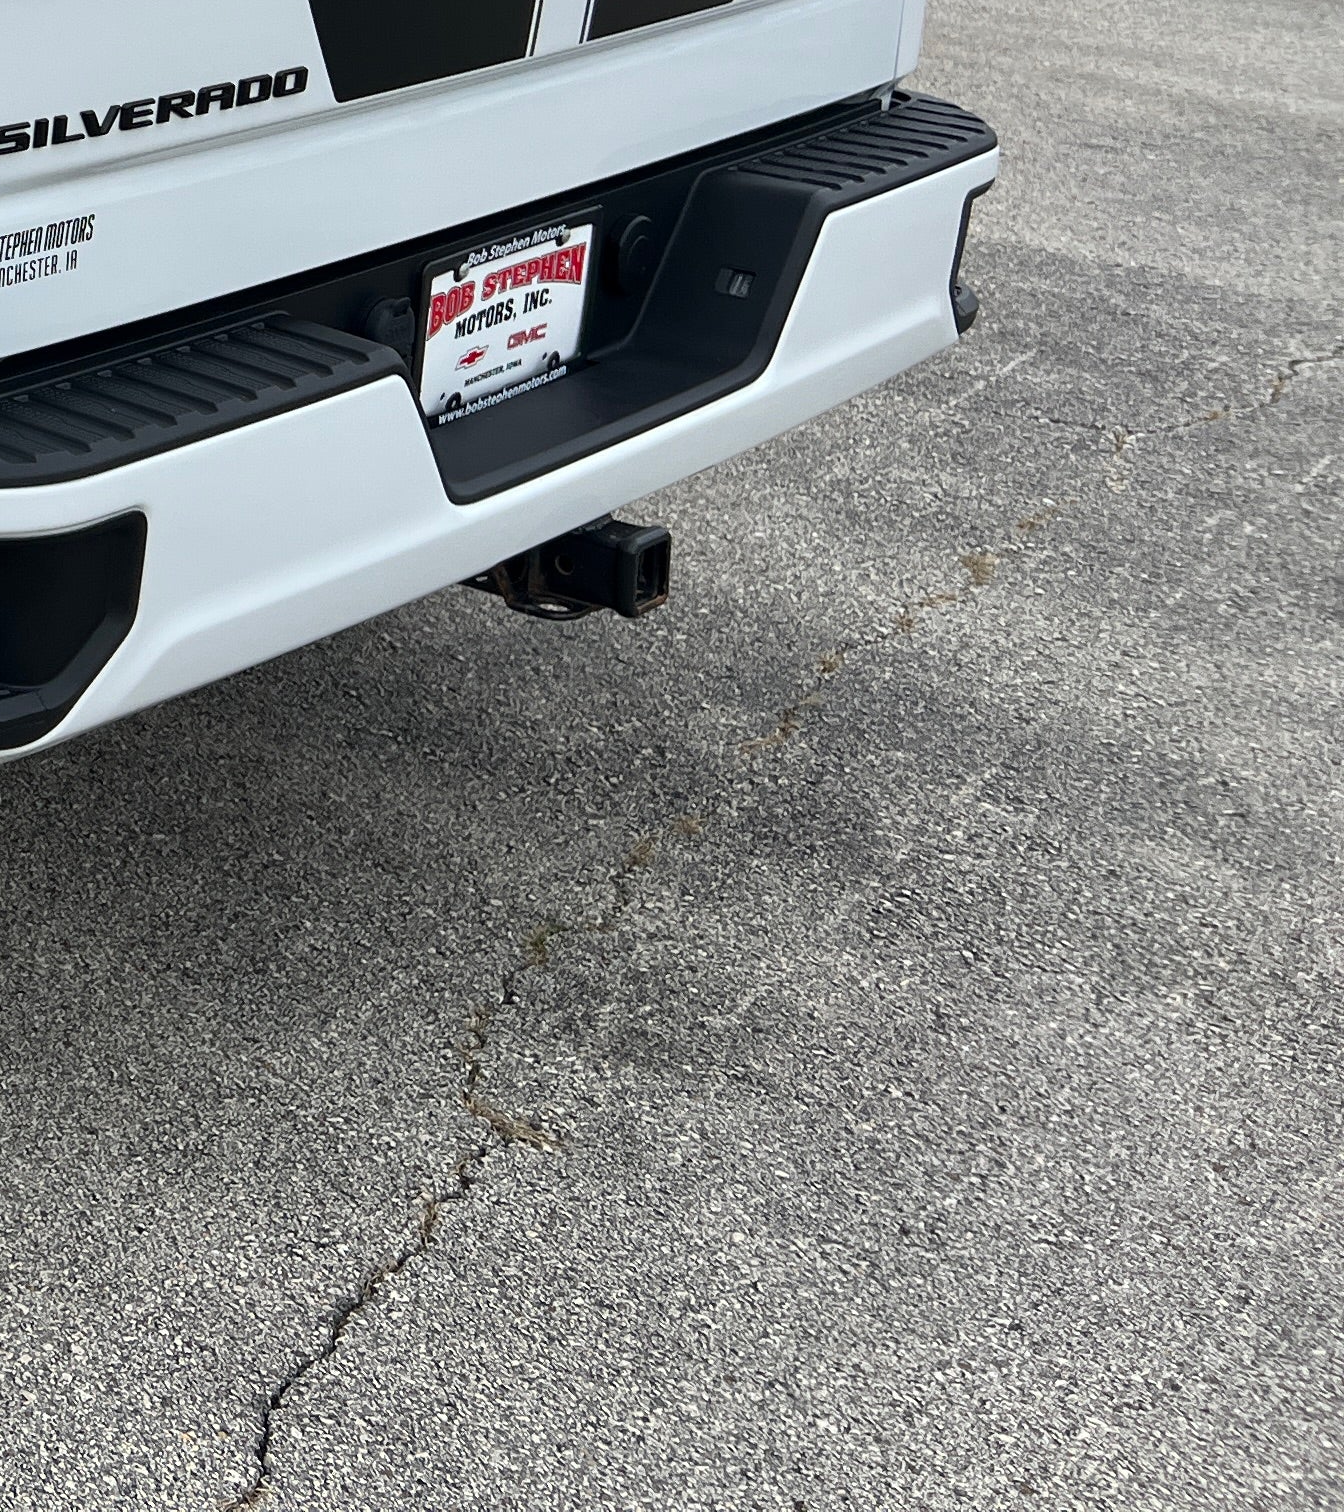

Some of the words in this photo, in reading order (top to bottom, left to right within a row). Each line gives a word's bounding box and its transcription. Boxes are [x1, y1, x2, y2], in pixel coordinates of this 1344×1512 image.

[43, 213, 96, 251] MOTORS
[467, 246, 486, 266] Bob
[489, 235, 530, 261] Stephen
[531, 224, 567, 245] Motors
[65, 249, 78, 271] IA
[426, 280, 476, 341] BOB
[480, 242, 587, 301] STEPHEN
[454, 298, 518, 339] MOTORS,
[522, 288, 553, 314] INC.
[507, 323, 548, 350] GMC
[438, 365, 568, 425] www.bobstephenmotors.com
